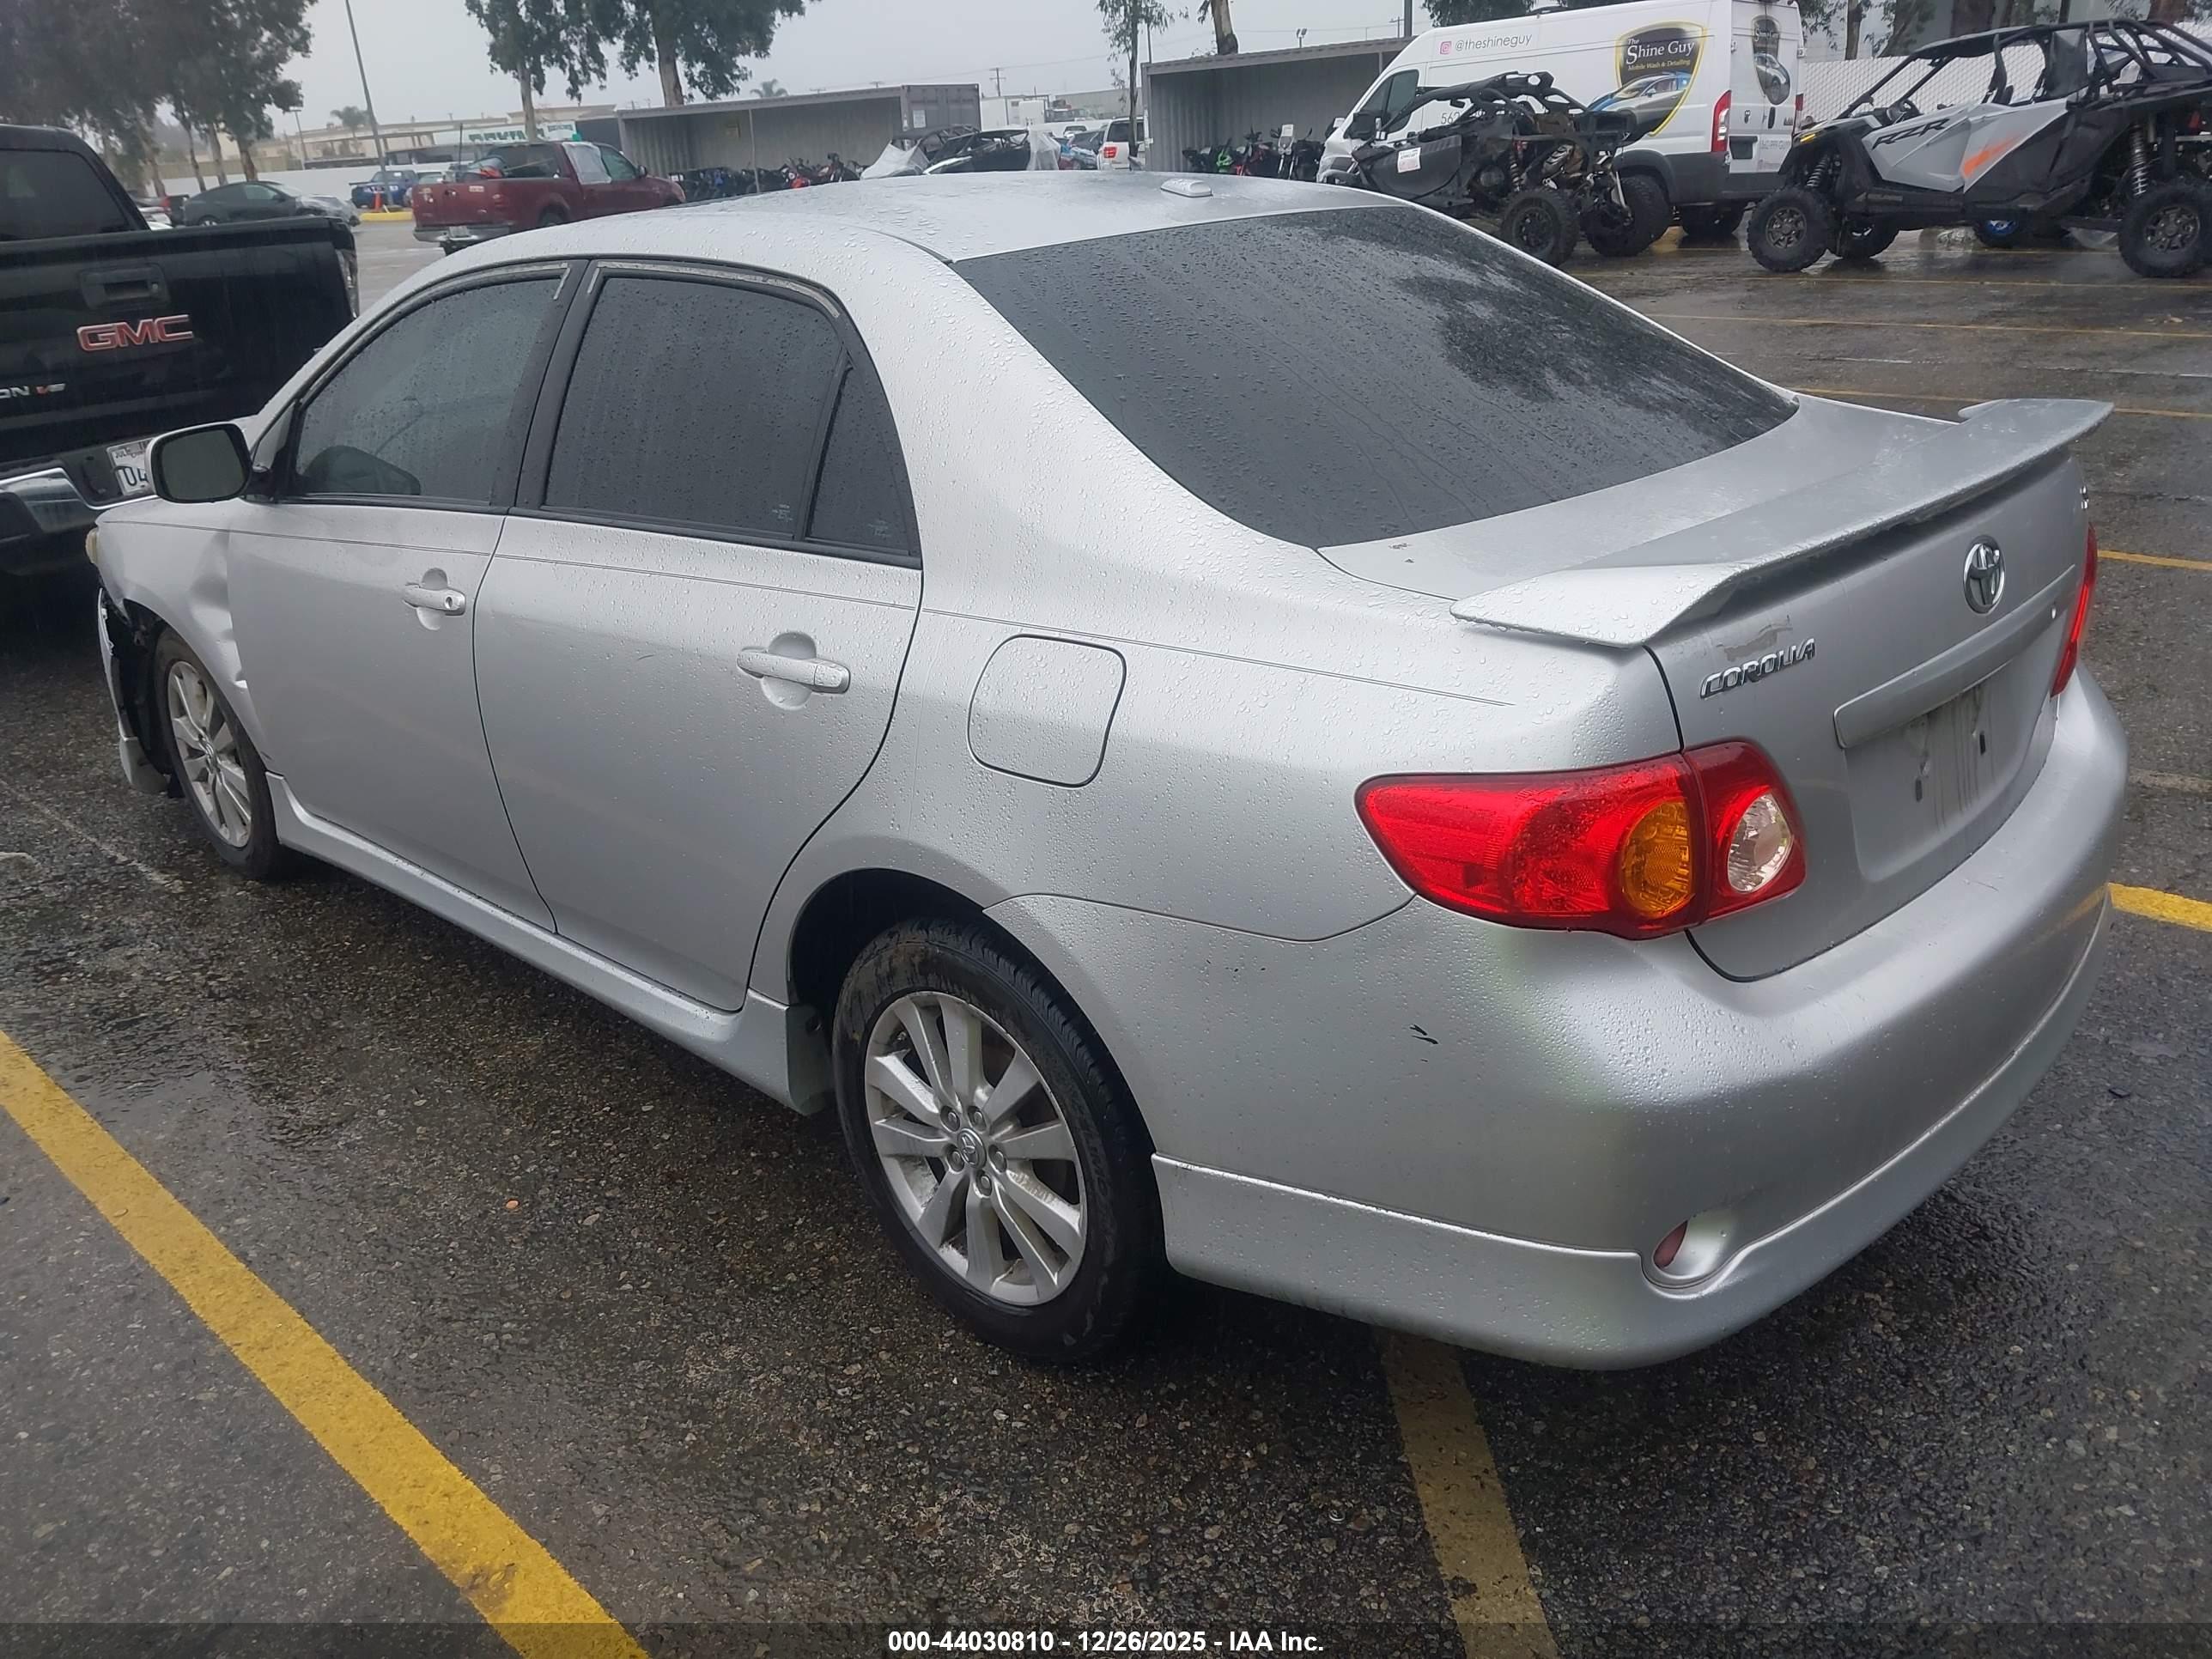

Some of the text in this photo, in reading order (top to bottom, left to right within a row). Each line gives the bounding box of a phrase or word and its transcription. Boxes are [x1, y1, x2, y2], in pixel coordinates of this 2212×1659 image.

[1455, 33, 1533, 52] @theshineguy
[1626, 40, 1695, 64] Shine Guy
[1872, 118, 1951, 150] RZR
[76, 314, 194, 351] GMC
[1700, 637, 1816, 699] COROLLA
